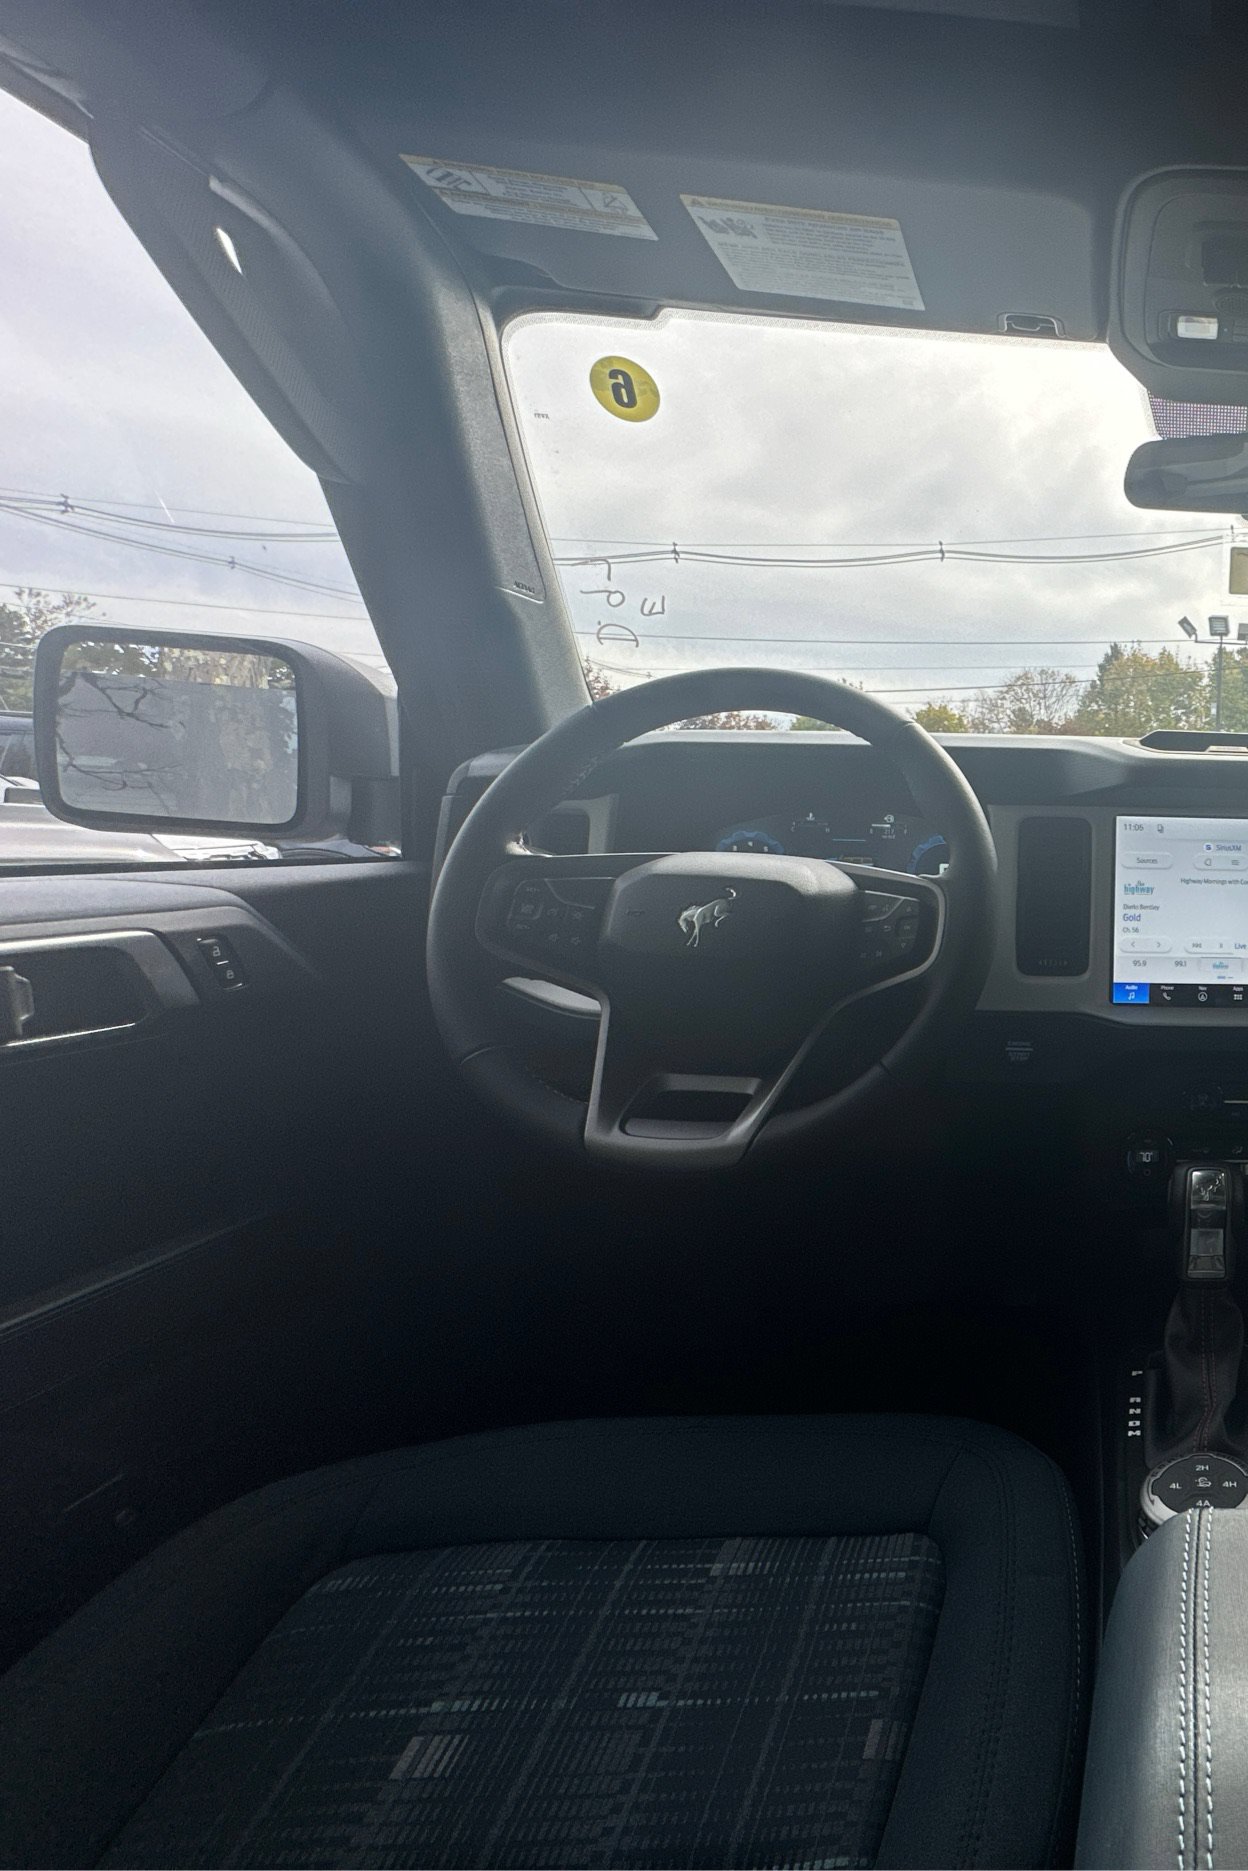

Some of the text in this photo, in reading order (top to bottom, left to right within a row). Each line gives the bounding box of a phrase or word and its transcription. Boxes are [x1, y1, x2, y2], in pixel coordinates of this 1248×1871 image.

[1136, 857, 1158, 865] Sources
[1181, 878, 1203, 886] Highway
[1122, 913, 1141, 922] Gold
[1234, 942, 1247, 950] Live
[1195, 1464, 1210, 1472] 2H
[1196, 1499, 1211, 1507] 4A
